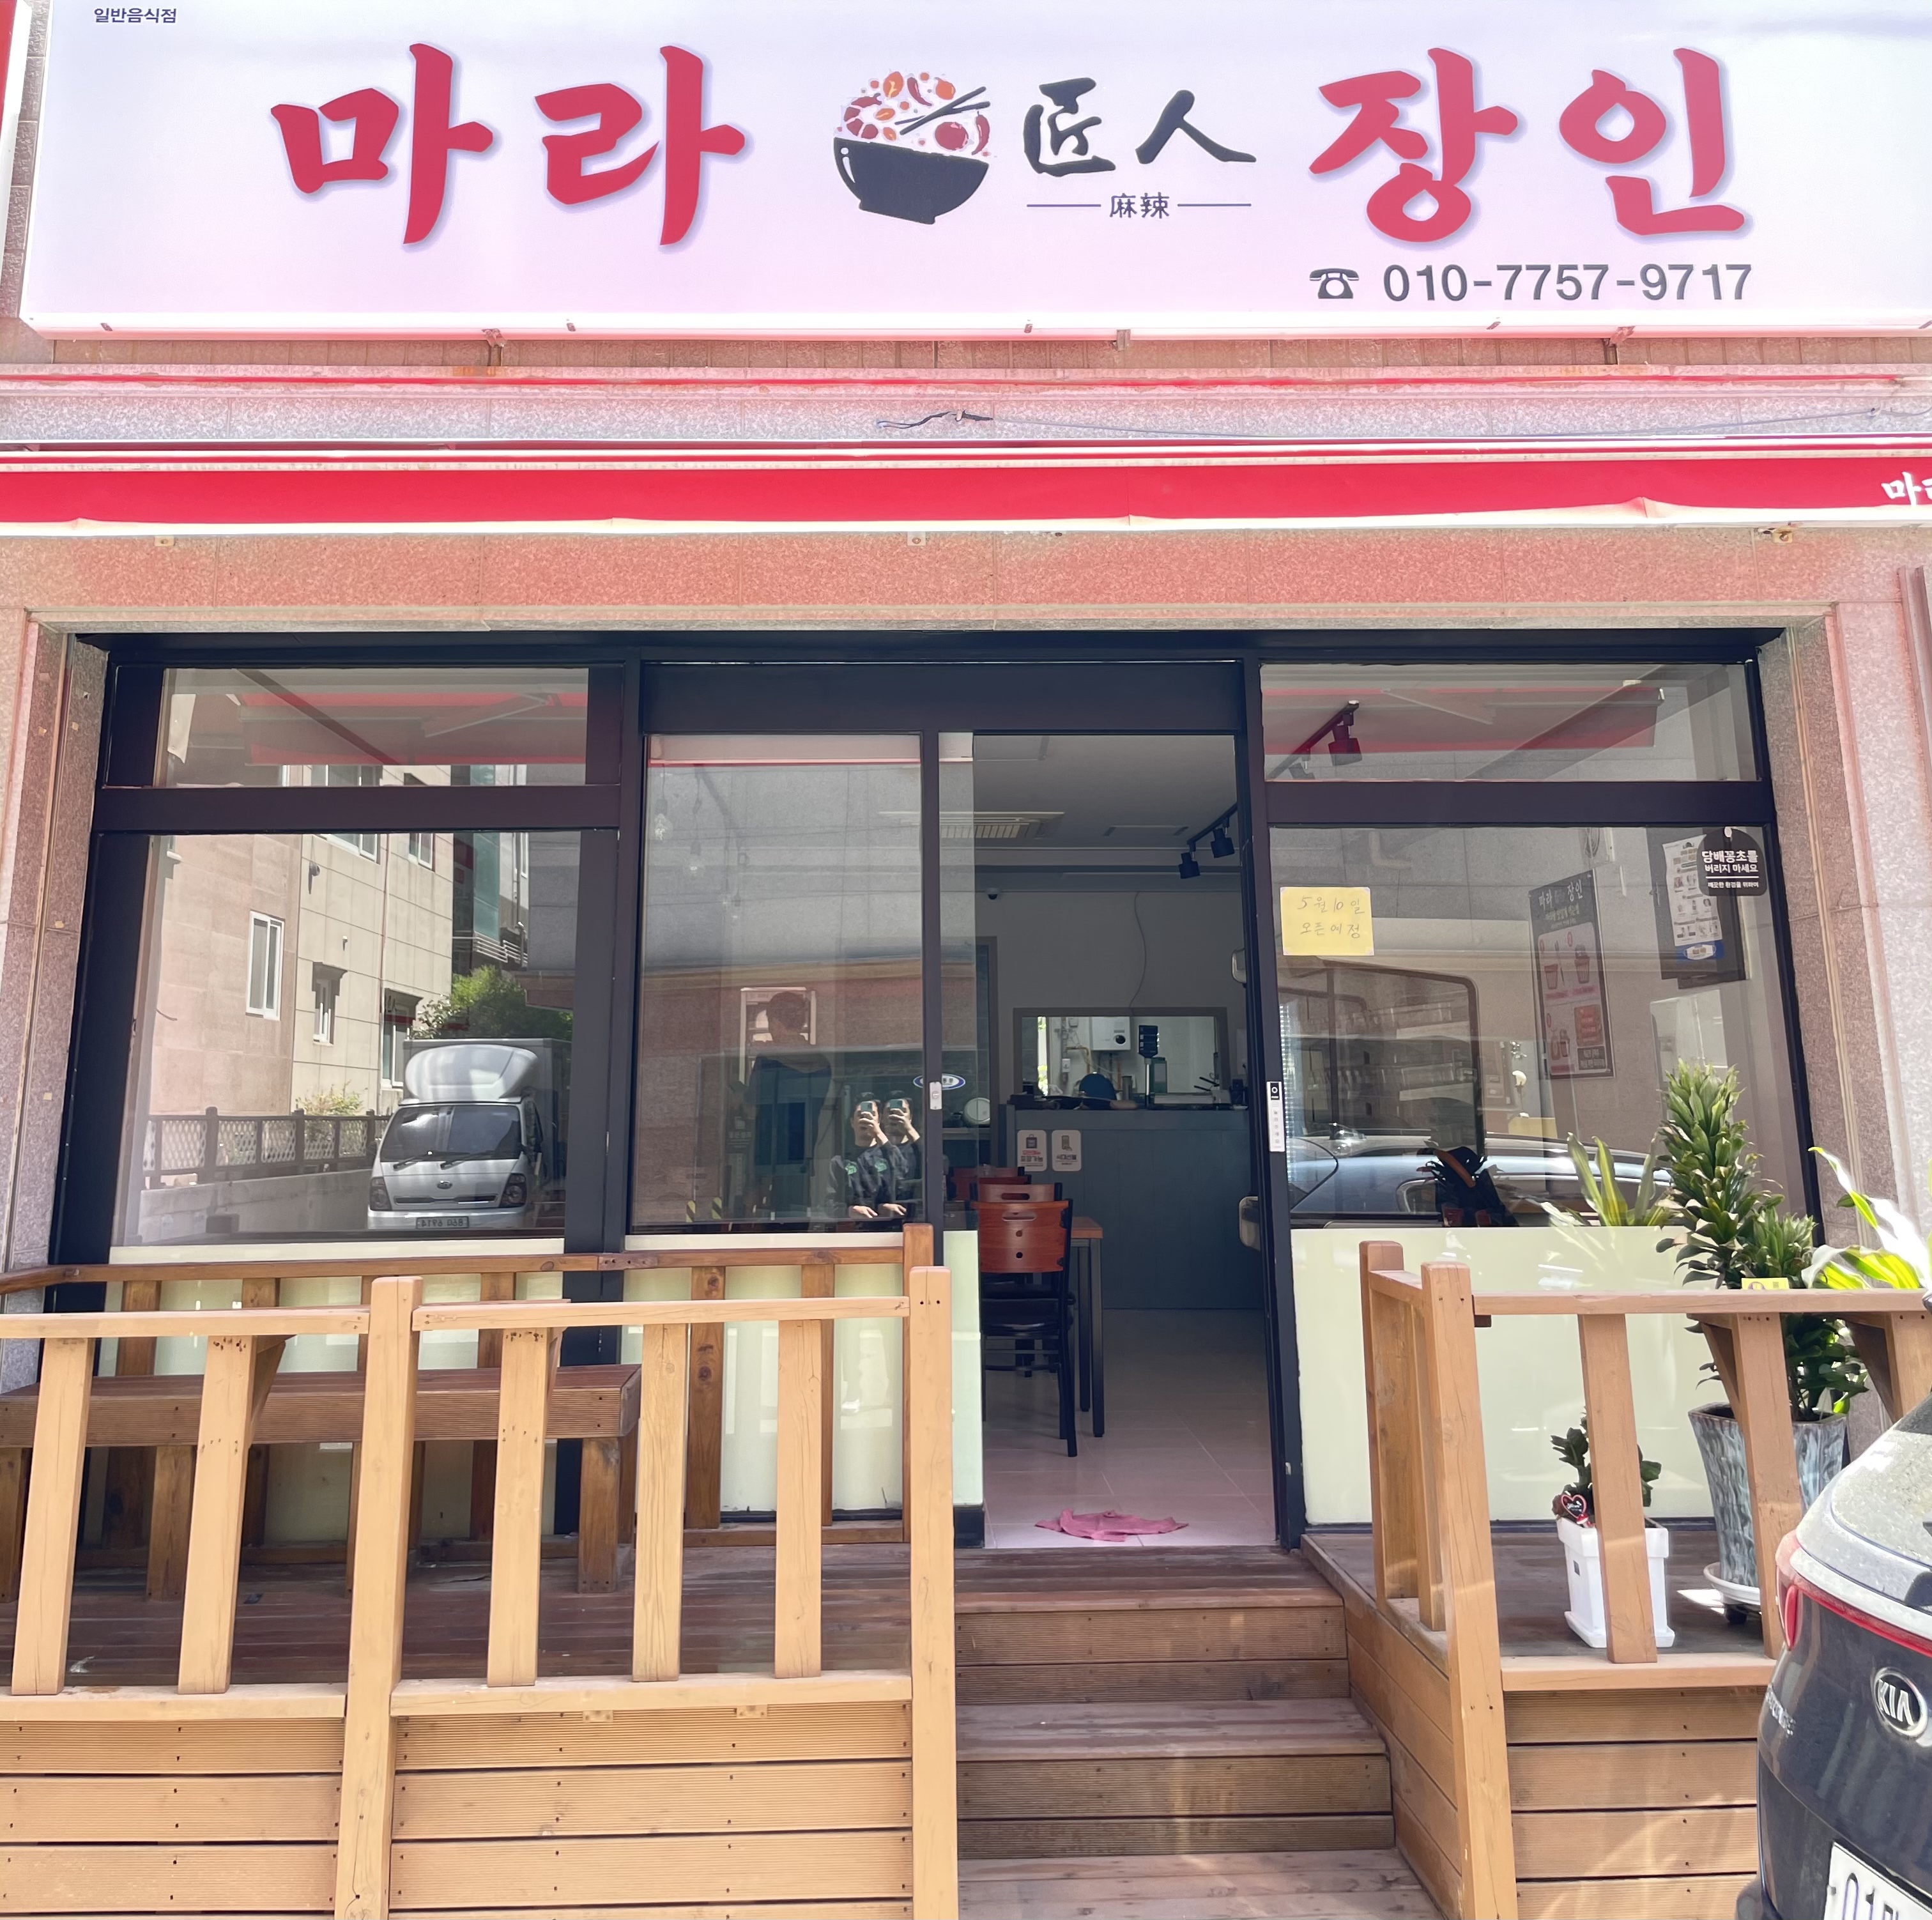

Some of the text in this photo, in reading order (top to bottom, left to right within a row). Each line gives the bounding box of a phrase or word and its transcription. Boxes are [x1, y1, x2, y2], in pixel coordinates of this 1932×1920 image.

[93, 6, 178, 24] 일반음식점
[270, 43, 748, 245] 마라
[1022, 76, 1257, 178] 匠人
[1308, 47, 1745, 243] 장인
[1108, 192, 1170, 220] 麻辣
[1383, 263, 1752, 302] 010-7757-9717
[1701, 850, 1758, 863] 담배꽁초를
[1704, 863, 1759, 873] 버리지 마세요
[1538, 879, 1583, 911] 마라 장인
[1877, 1678, 1914, 1727] KIA
